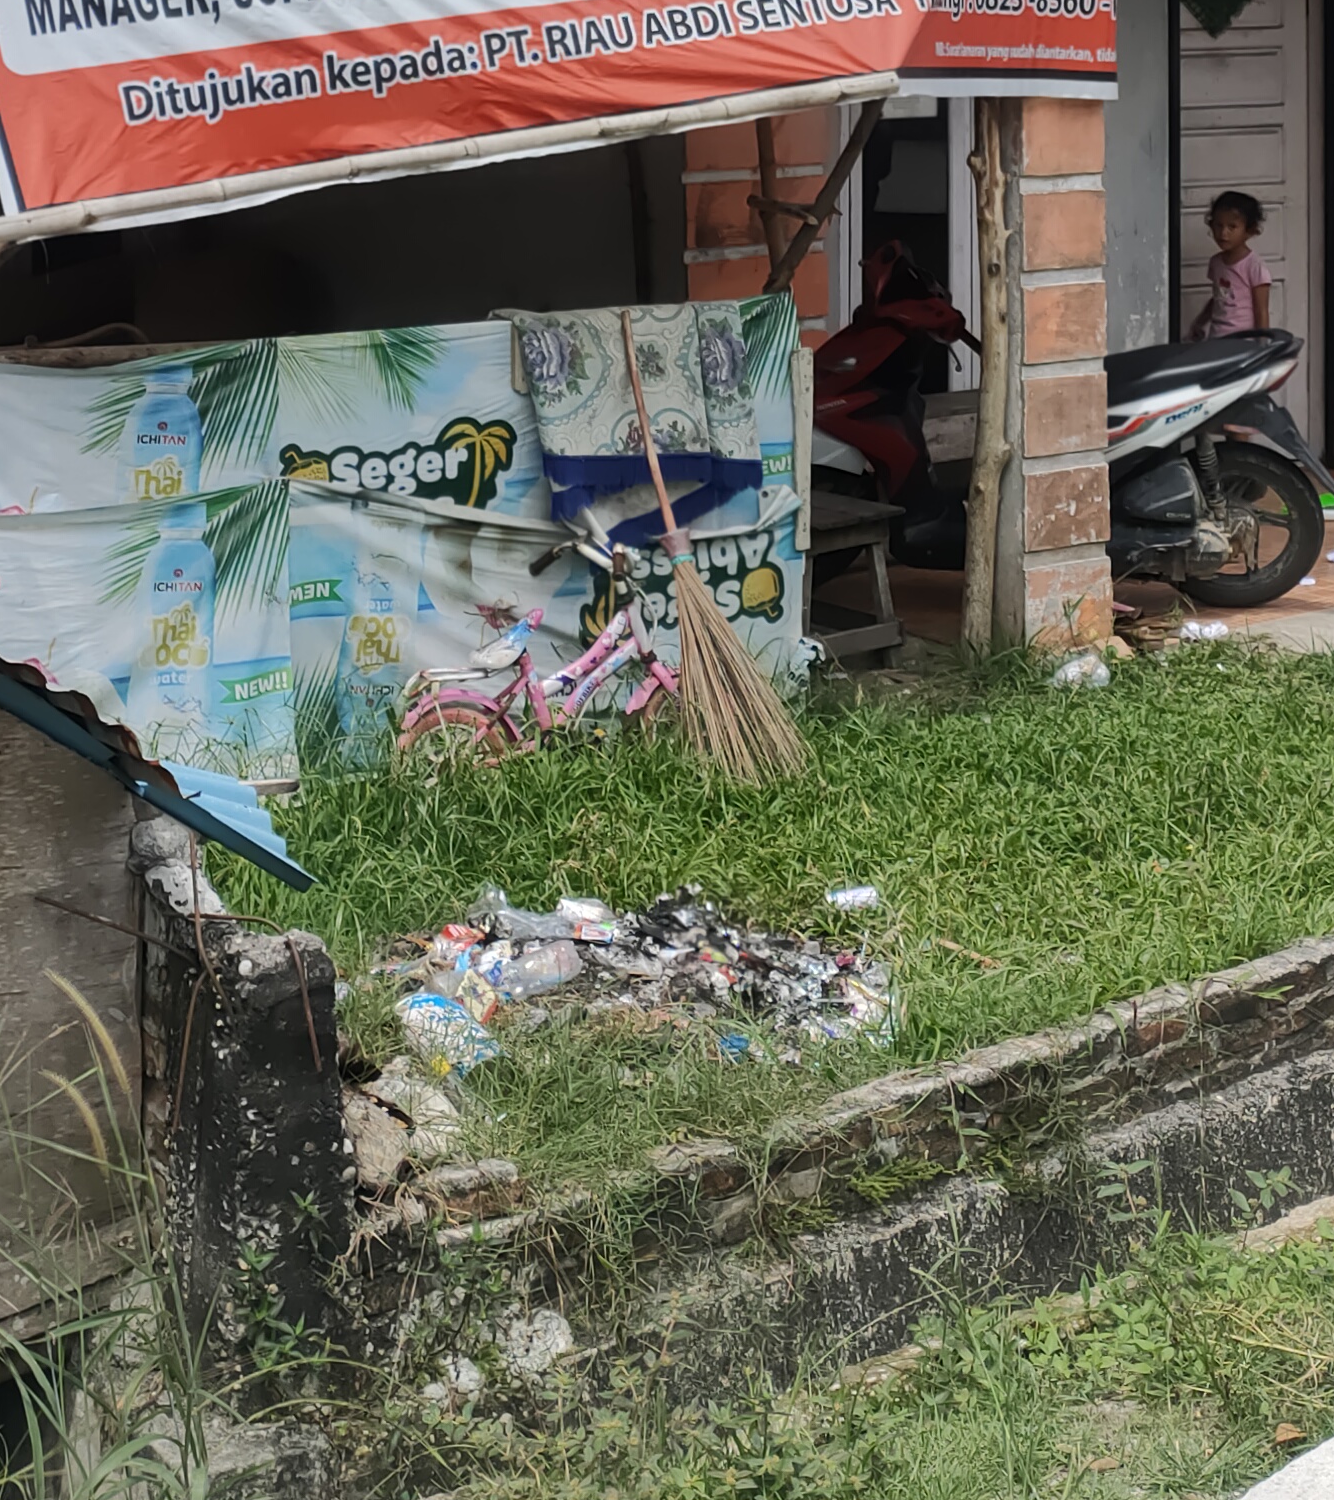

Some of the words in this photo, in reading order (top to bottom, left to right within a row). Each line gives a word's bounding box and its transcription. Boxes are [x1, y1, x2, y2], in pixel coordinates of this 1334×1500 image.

[122, 64, 319, 127] Ditujukan
[326, 44, 479, 97] kepada:
[483, 28, 544, 70] PT.
[547, 17, 634, 62] RIAU
[644, 0, 733, 47] ABDI
[136, 434, 187, 446] ICHITAN
[330, 447, 469, 496] Seger
[153, 582, 203, 593] ICHITAN
[233, 671, 288, 701] NEW!!
